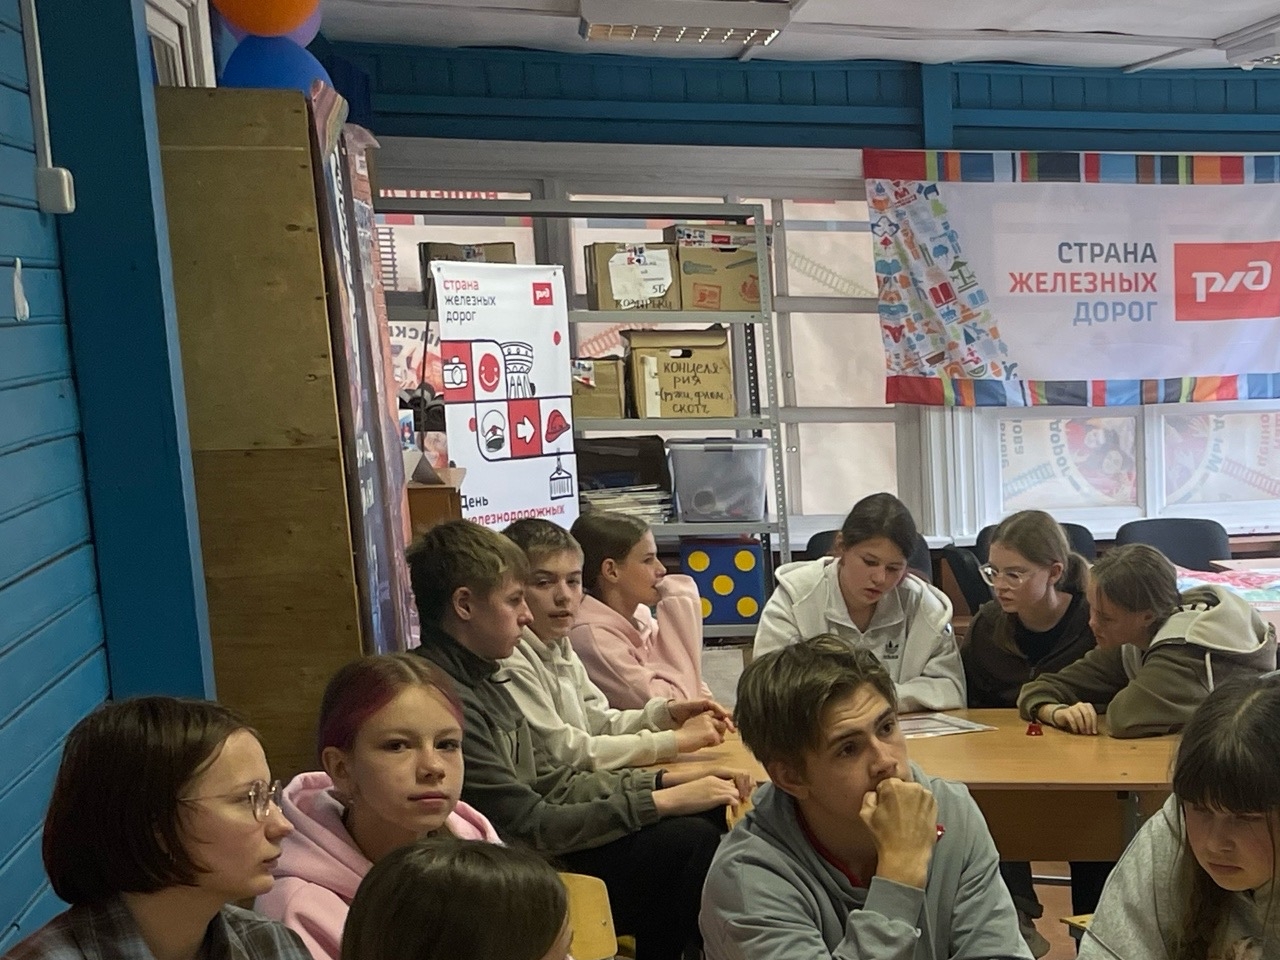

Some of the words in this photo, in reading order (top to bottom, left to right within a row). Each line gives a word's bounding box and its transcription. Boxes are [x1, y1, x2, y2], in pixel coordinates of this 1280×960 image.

[1057, 241, 1158, 264] СТРАНА
[443, 280, 480, 293] страна
[1008, 272, 1158, 293] ЖЕЛЕЗНЫХ
[444, 295, 497, 306] железных
[446, 310, 477, 326] дорог
[1072, 301, 1158, 326] ДОРОГ
[461, 495, 489, 511] День
[468, 505, 565, 525] елезнодорожных
